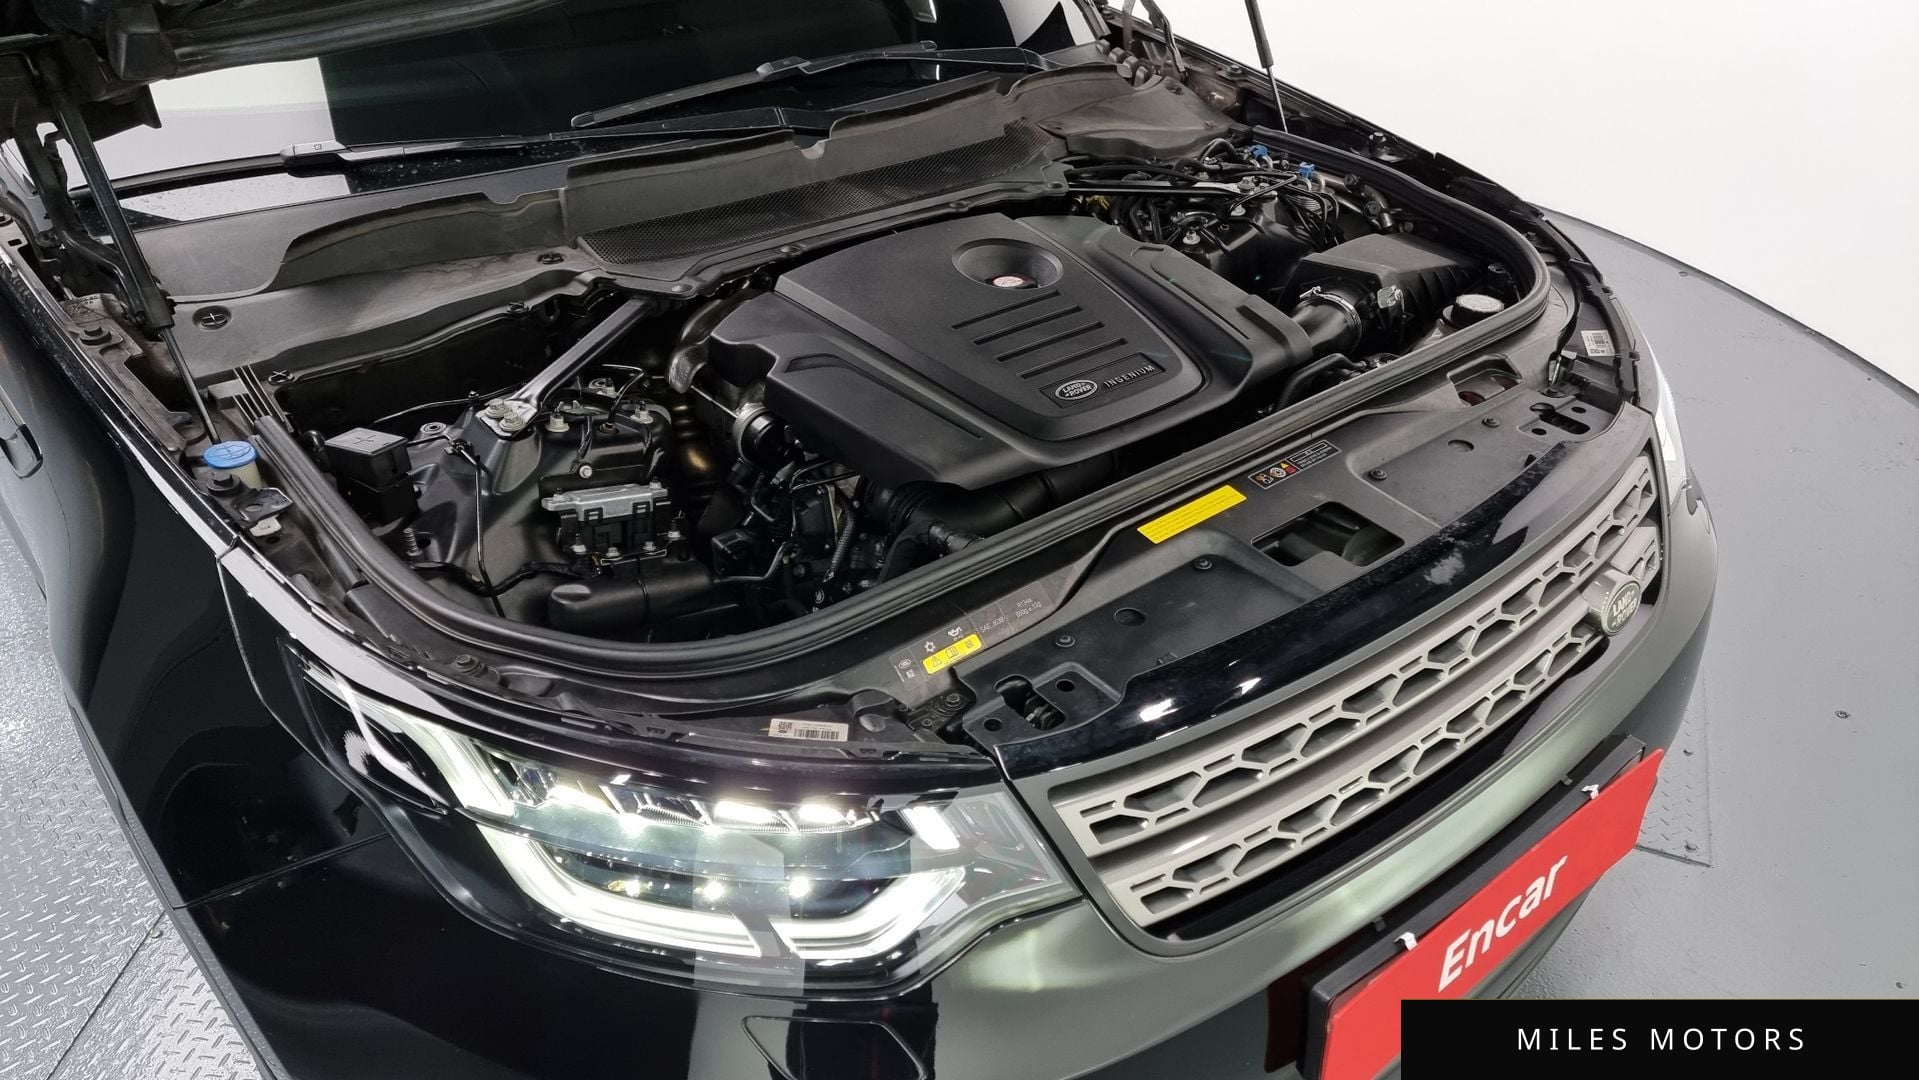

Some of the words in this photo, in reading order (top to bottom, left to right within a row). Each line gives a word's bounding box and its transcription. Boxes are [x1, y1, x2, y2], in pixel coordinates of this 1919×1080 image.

[1062, 383, 1082, 393] LAND
[1103, 365, 1155, 388] INGENIUM
[1069, 384, 1092, 397] ROVER
[1612, 591, 1631, 617] LAND
[1437, 855, 1568, 993] Encar
